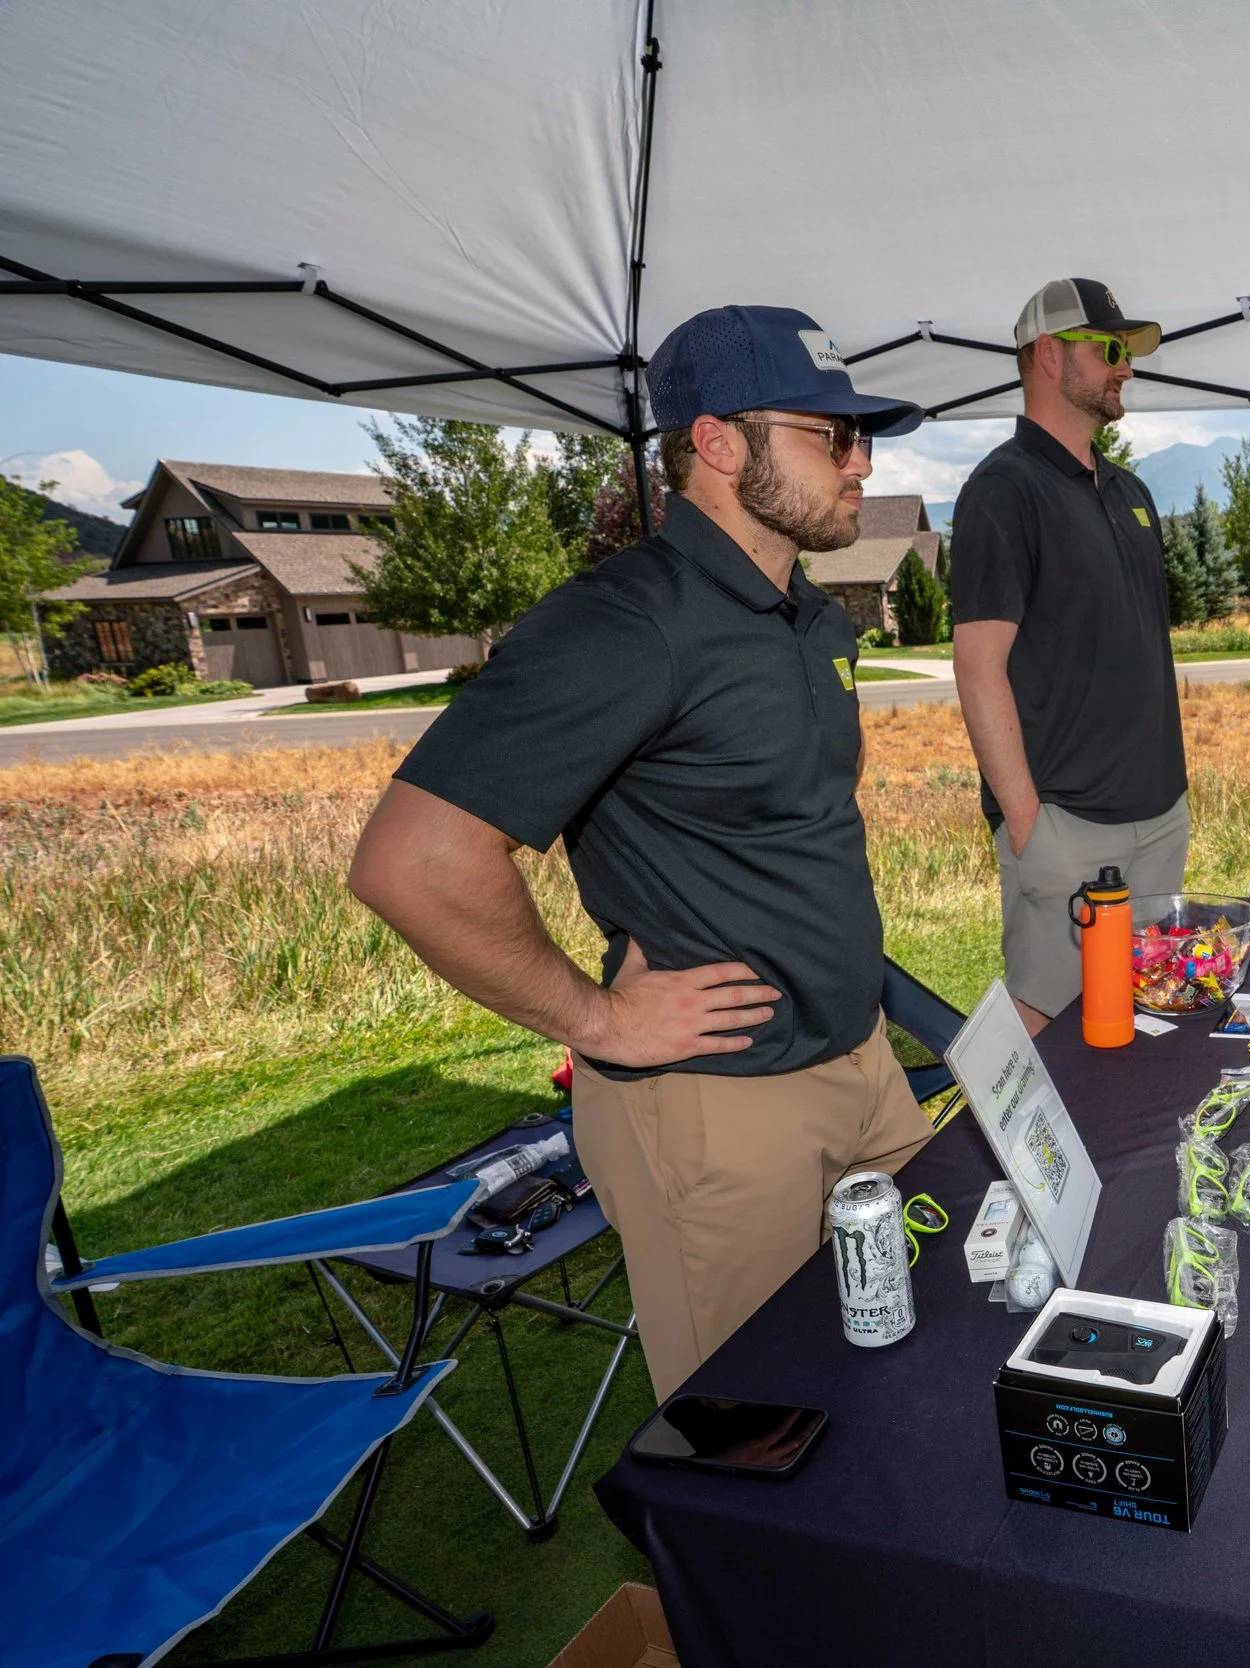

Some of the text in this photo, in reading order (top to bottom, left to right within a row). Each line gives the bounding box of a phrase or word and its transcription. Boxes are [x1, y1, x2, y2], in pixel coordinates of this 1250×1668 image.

[818, 352, 843, 362] PARA
[992, 1050, 1020, 1100] Scan here to
[999, 1057, 1036, 1132] enter our drawing!
[970, 1250, 1004, 1261] Titleist
[842, 1304, 891, 1318] NSTER
[1056, 1404, 1113, 1418] BUSHNELLGOLF.COM
[1113, 1498, 1137, 1509] SHIFT
[1113, 1506, 1129, 1518] V6
[1133, 1509, 1171, 1525] TOUR
